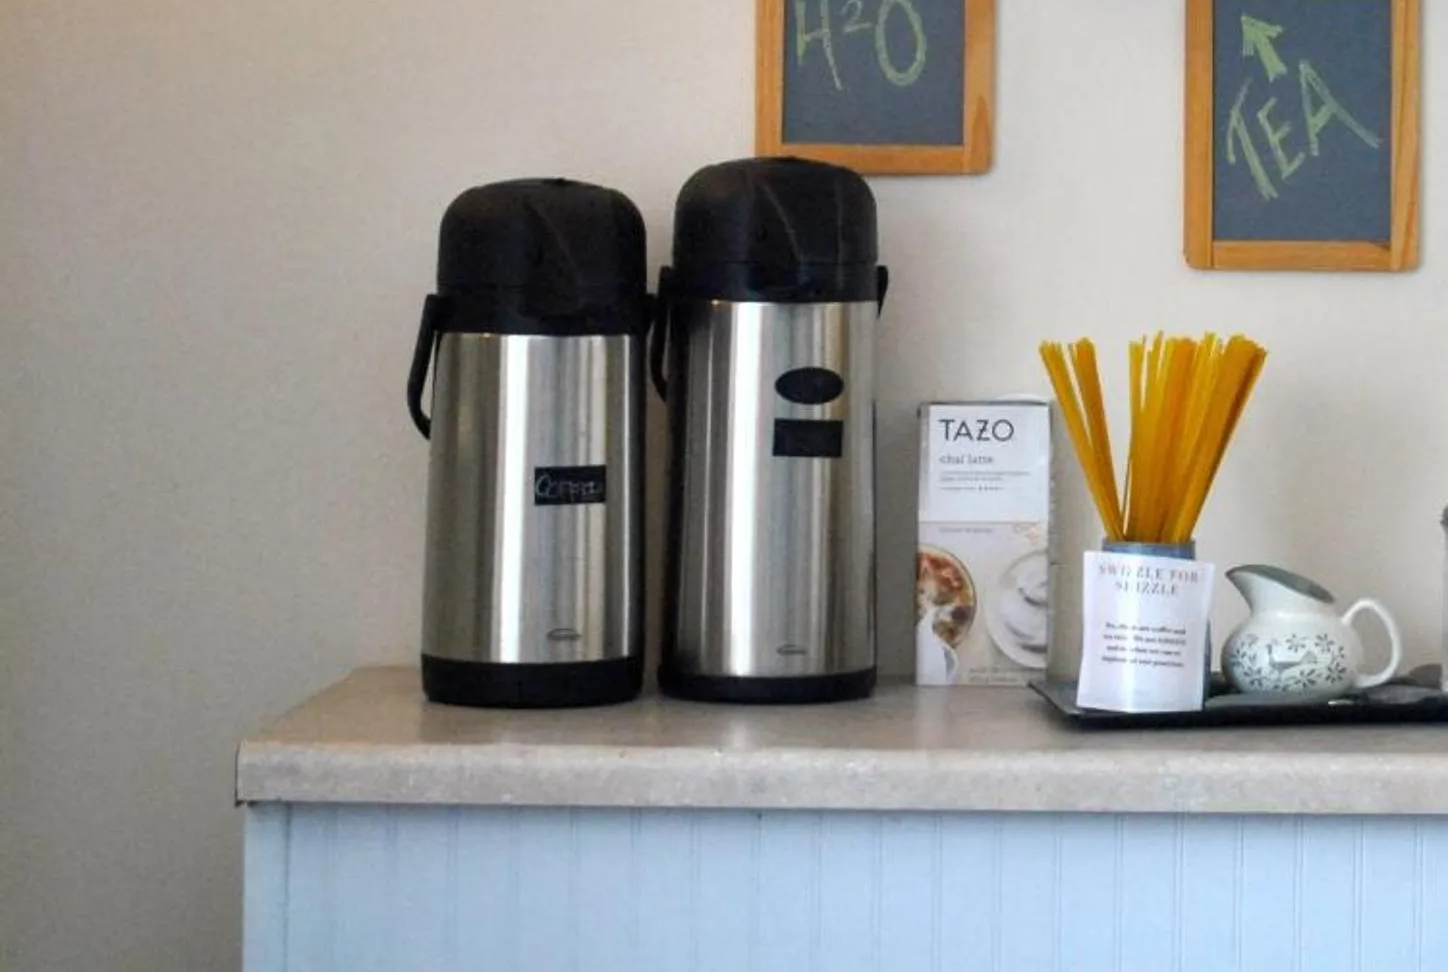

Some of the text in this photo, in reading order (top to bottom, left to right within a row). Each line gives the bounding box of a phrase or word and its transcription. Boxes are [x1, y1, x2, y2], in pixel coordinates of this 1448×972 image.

[1226, 59, 1384, 201] TEA
[937, 419, 1015, 442] TAZO
[939, 452, 995, 465] chai latte
